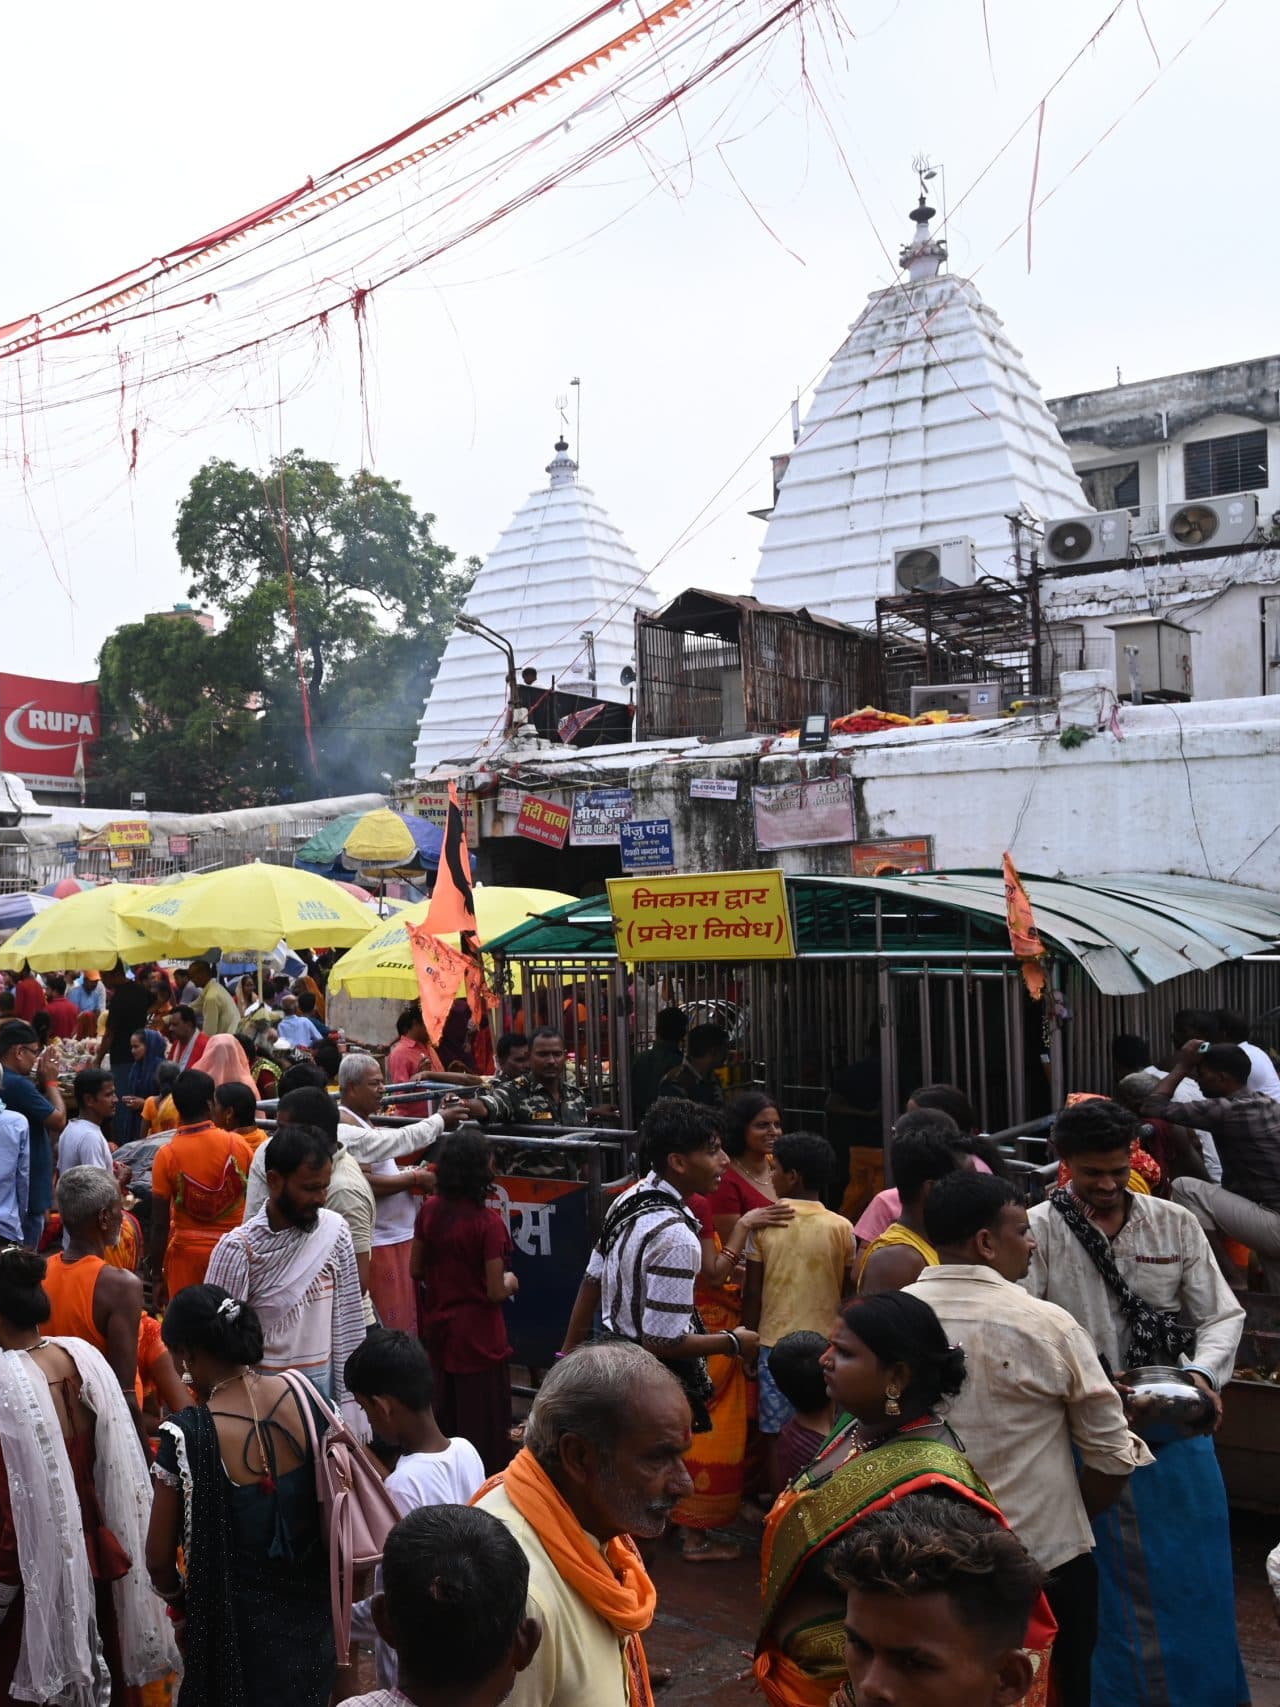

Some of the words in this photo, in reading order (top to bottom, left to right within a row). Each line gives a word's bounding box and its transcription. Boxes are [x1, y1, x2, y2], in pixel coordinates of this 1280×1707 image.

[29, 709, 94, 735] RUPA
[522, 801, 543, 821] नंदी
[543, 810, 569, 830] बाबा
[646, 821, 669, 836] पंडा
[632, 887, 720, 910] निकास
[724, 888, 770, 911] द्वार
[626, 918, 699, 948] (प्रवेश
[702, 914, 784, 945] निषेध)
